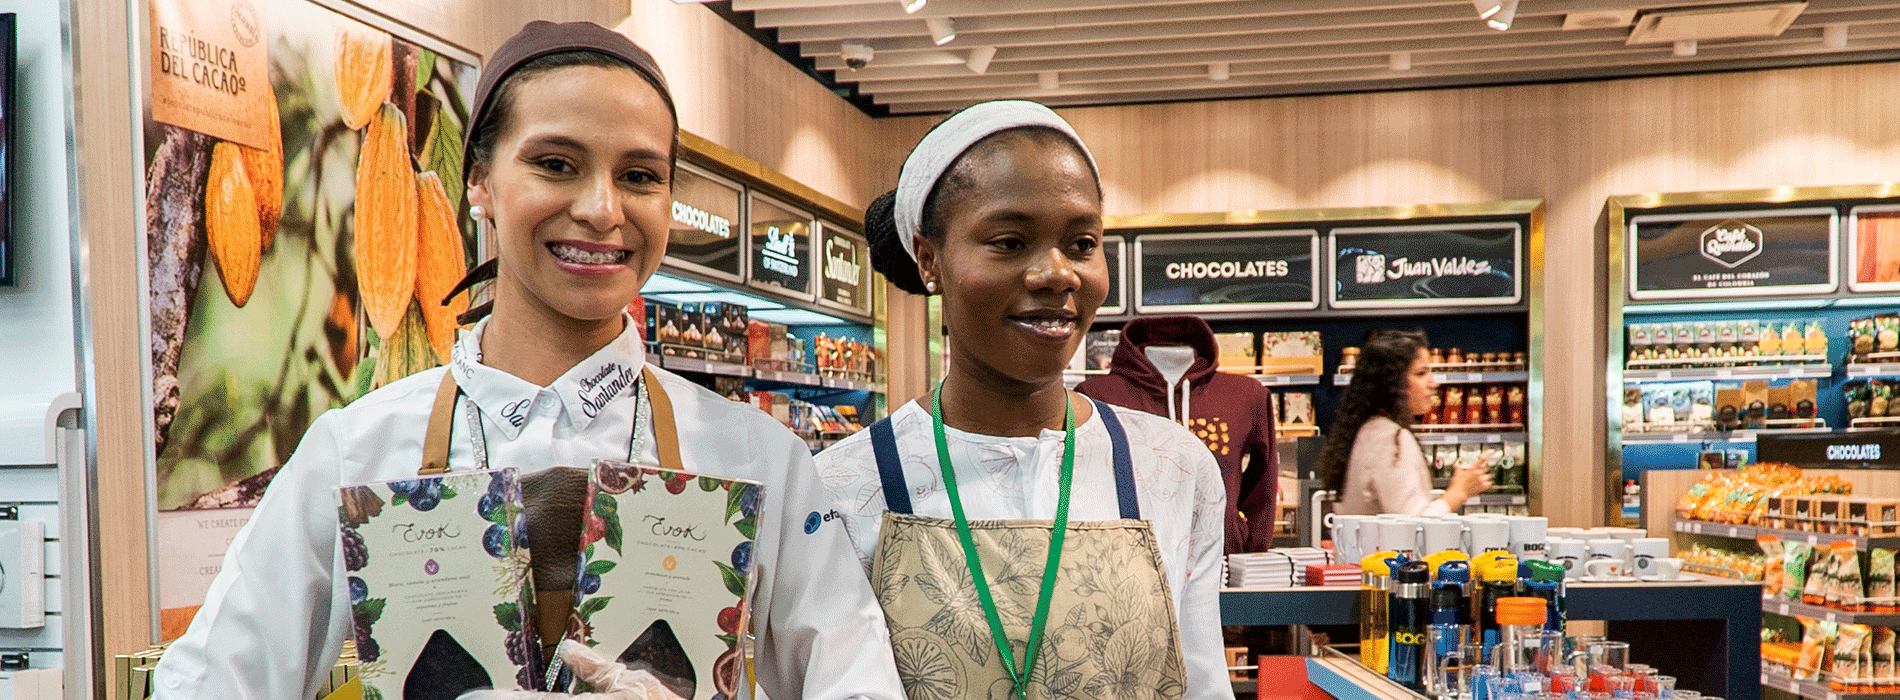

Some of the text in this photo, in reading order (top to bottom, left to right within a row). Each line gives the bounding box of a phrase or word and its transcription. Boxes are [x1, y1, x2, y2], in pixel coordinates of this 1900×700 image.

[160, 26, 238, 75] REPÚBLICA
[161, 51, 188, 80] DEL
[671, 200, 730, 239] CHOCOLATES
[1165, 260, 1289, 279] CHOCOLATES
[1386, 256, 1492, 279] Juan Valdez
[578, 364, 634, 419] Santander
[580, 363, 616, 393] Chocolate
[1826, 444, 1882, 460] CHOCOLATES
[211, 518, 237, 529] CREATE
